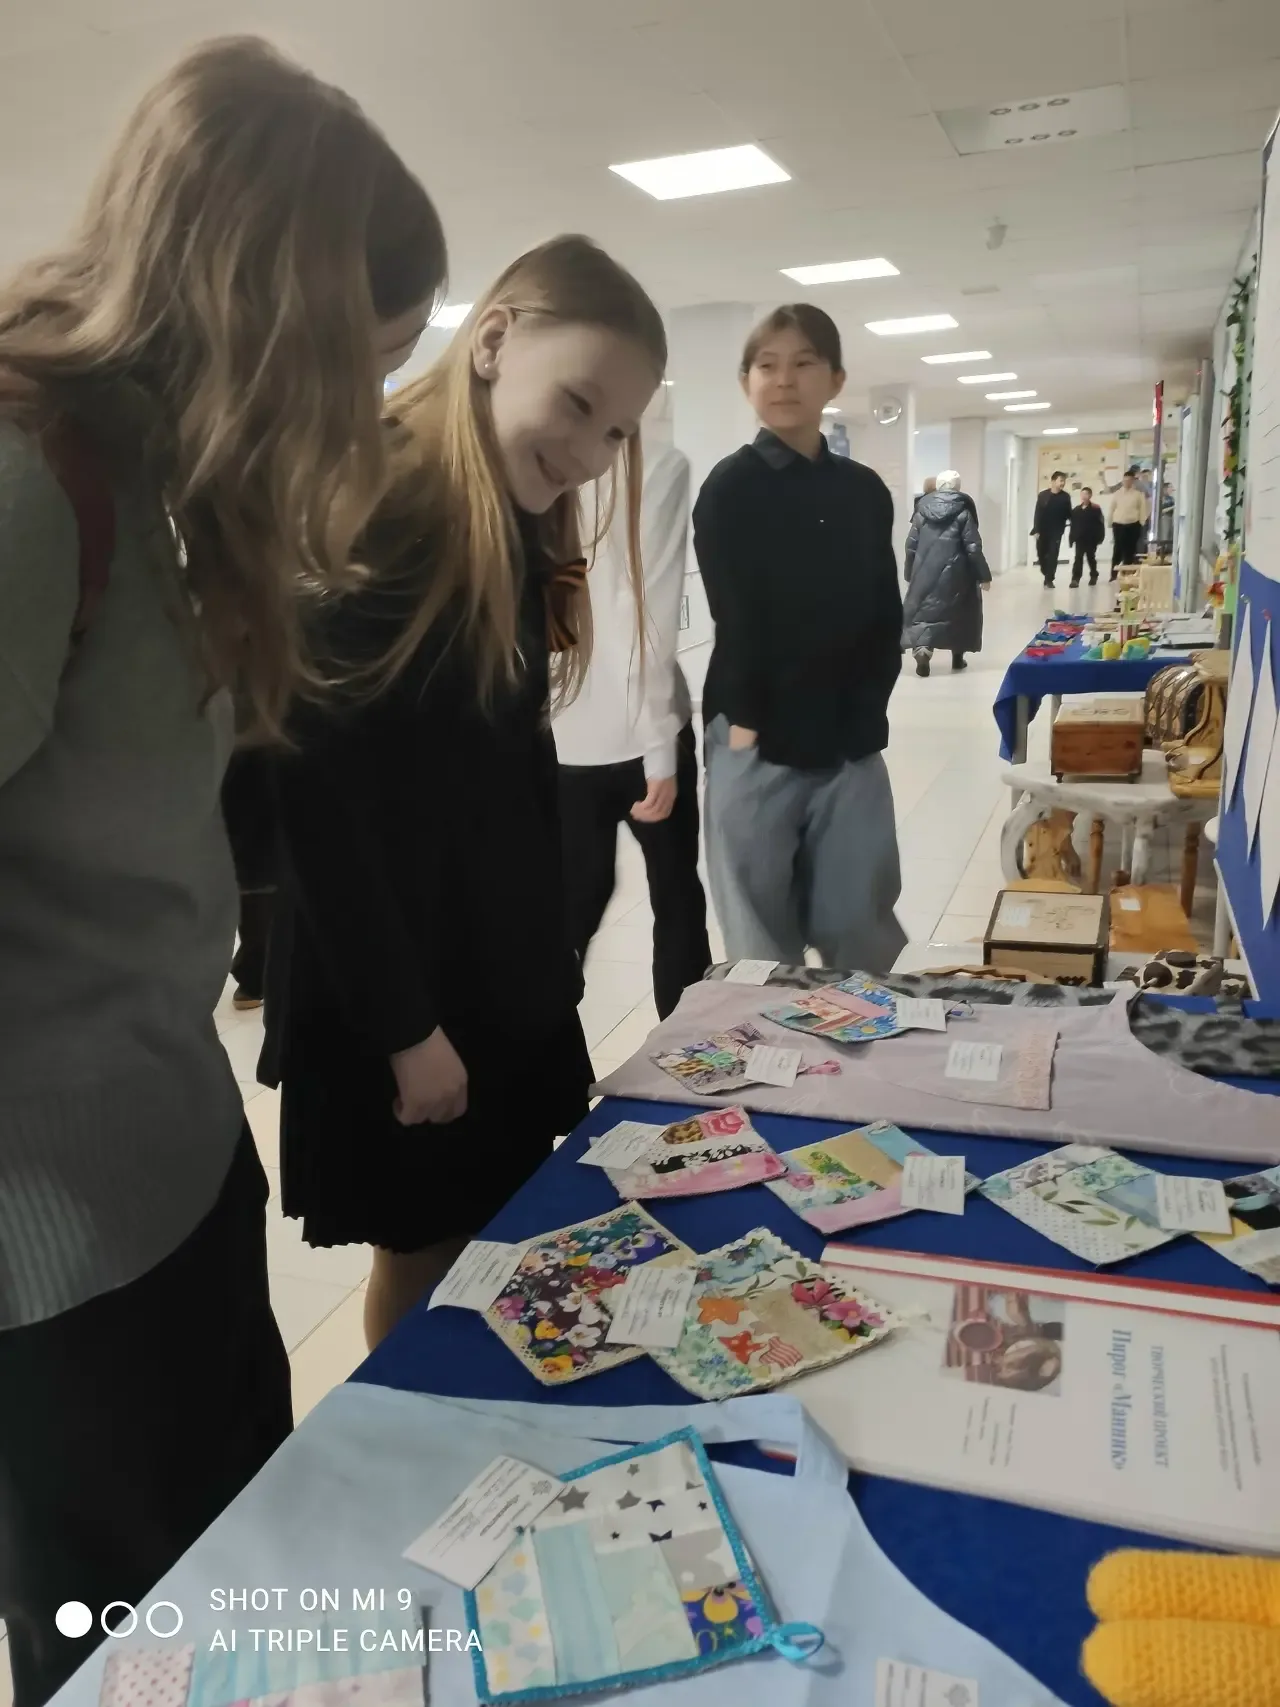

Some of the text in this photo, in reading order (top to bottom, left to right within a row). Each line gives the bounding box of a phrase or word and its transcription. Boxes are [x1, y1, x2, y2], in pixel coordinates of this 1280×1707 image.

[1106, 1328, 1132, 1471] Пирог «Манник»
[1149, 1345, 1169, 1469] ТВОРЧЕСКИЙ ПРОЕКТ
